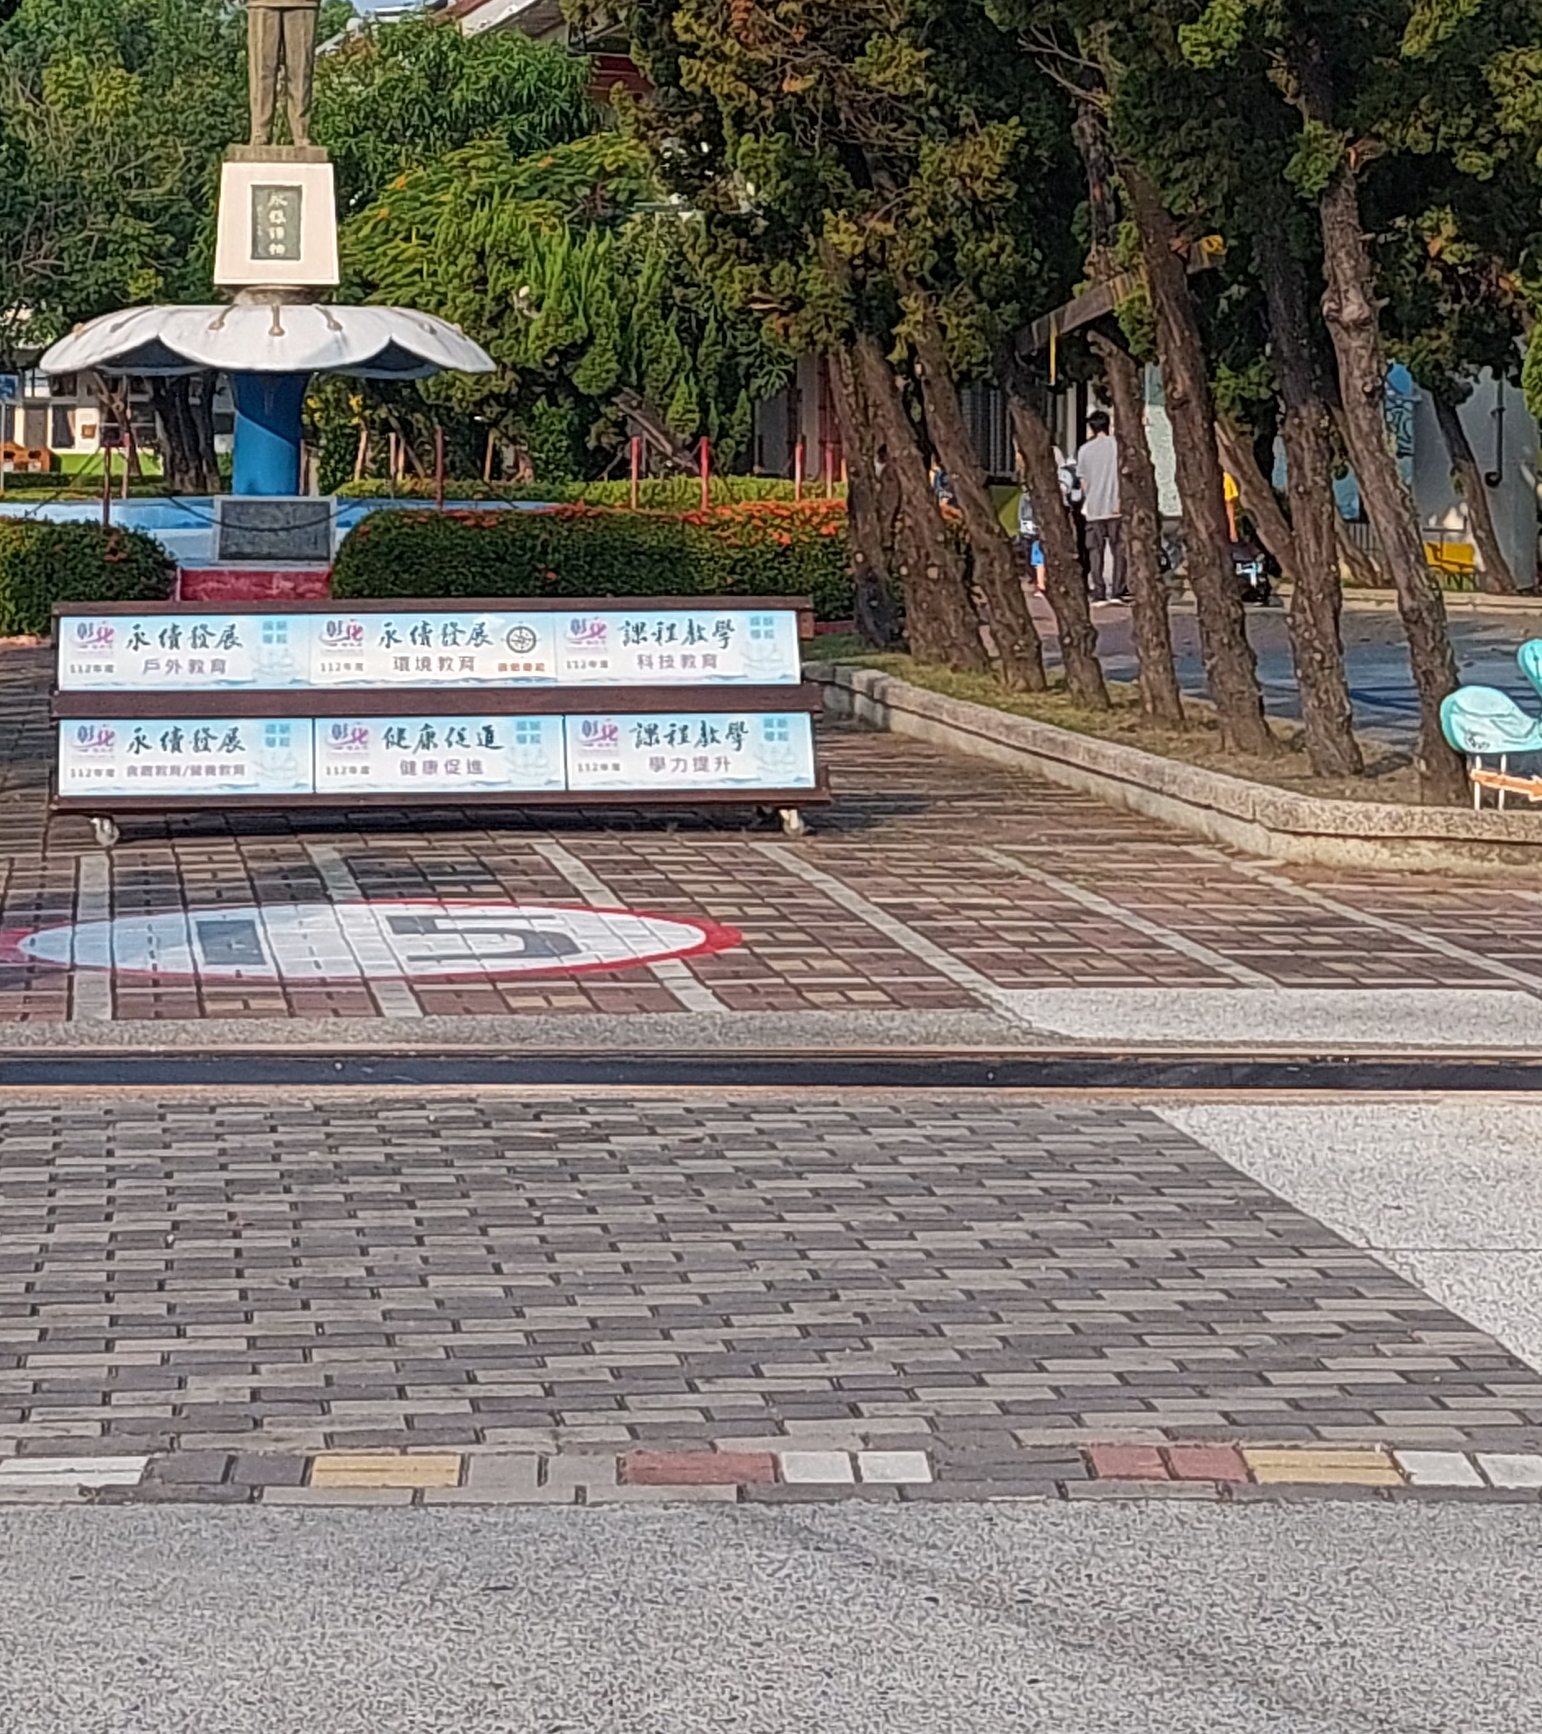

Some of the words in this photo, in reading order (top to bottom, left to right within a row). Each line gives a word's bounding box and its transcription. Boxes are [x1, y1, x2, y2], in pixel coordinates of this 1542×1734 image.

[399, 759, 484, 776] 健康促進
[649, 756, 732, 774] 學力提升
